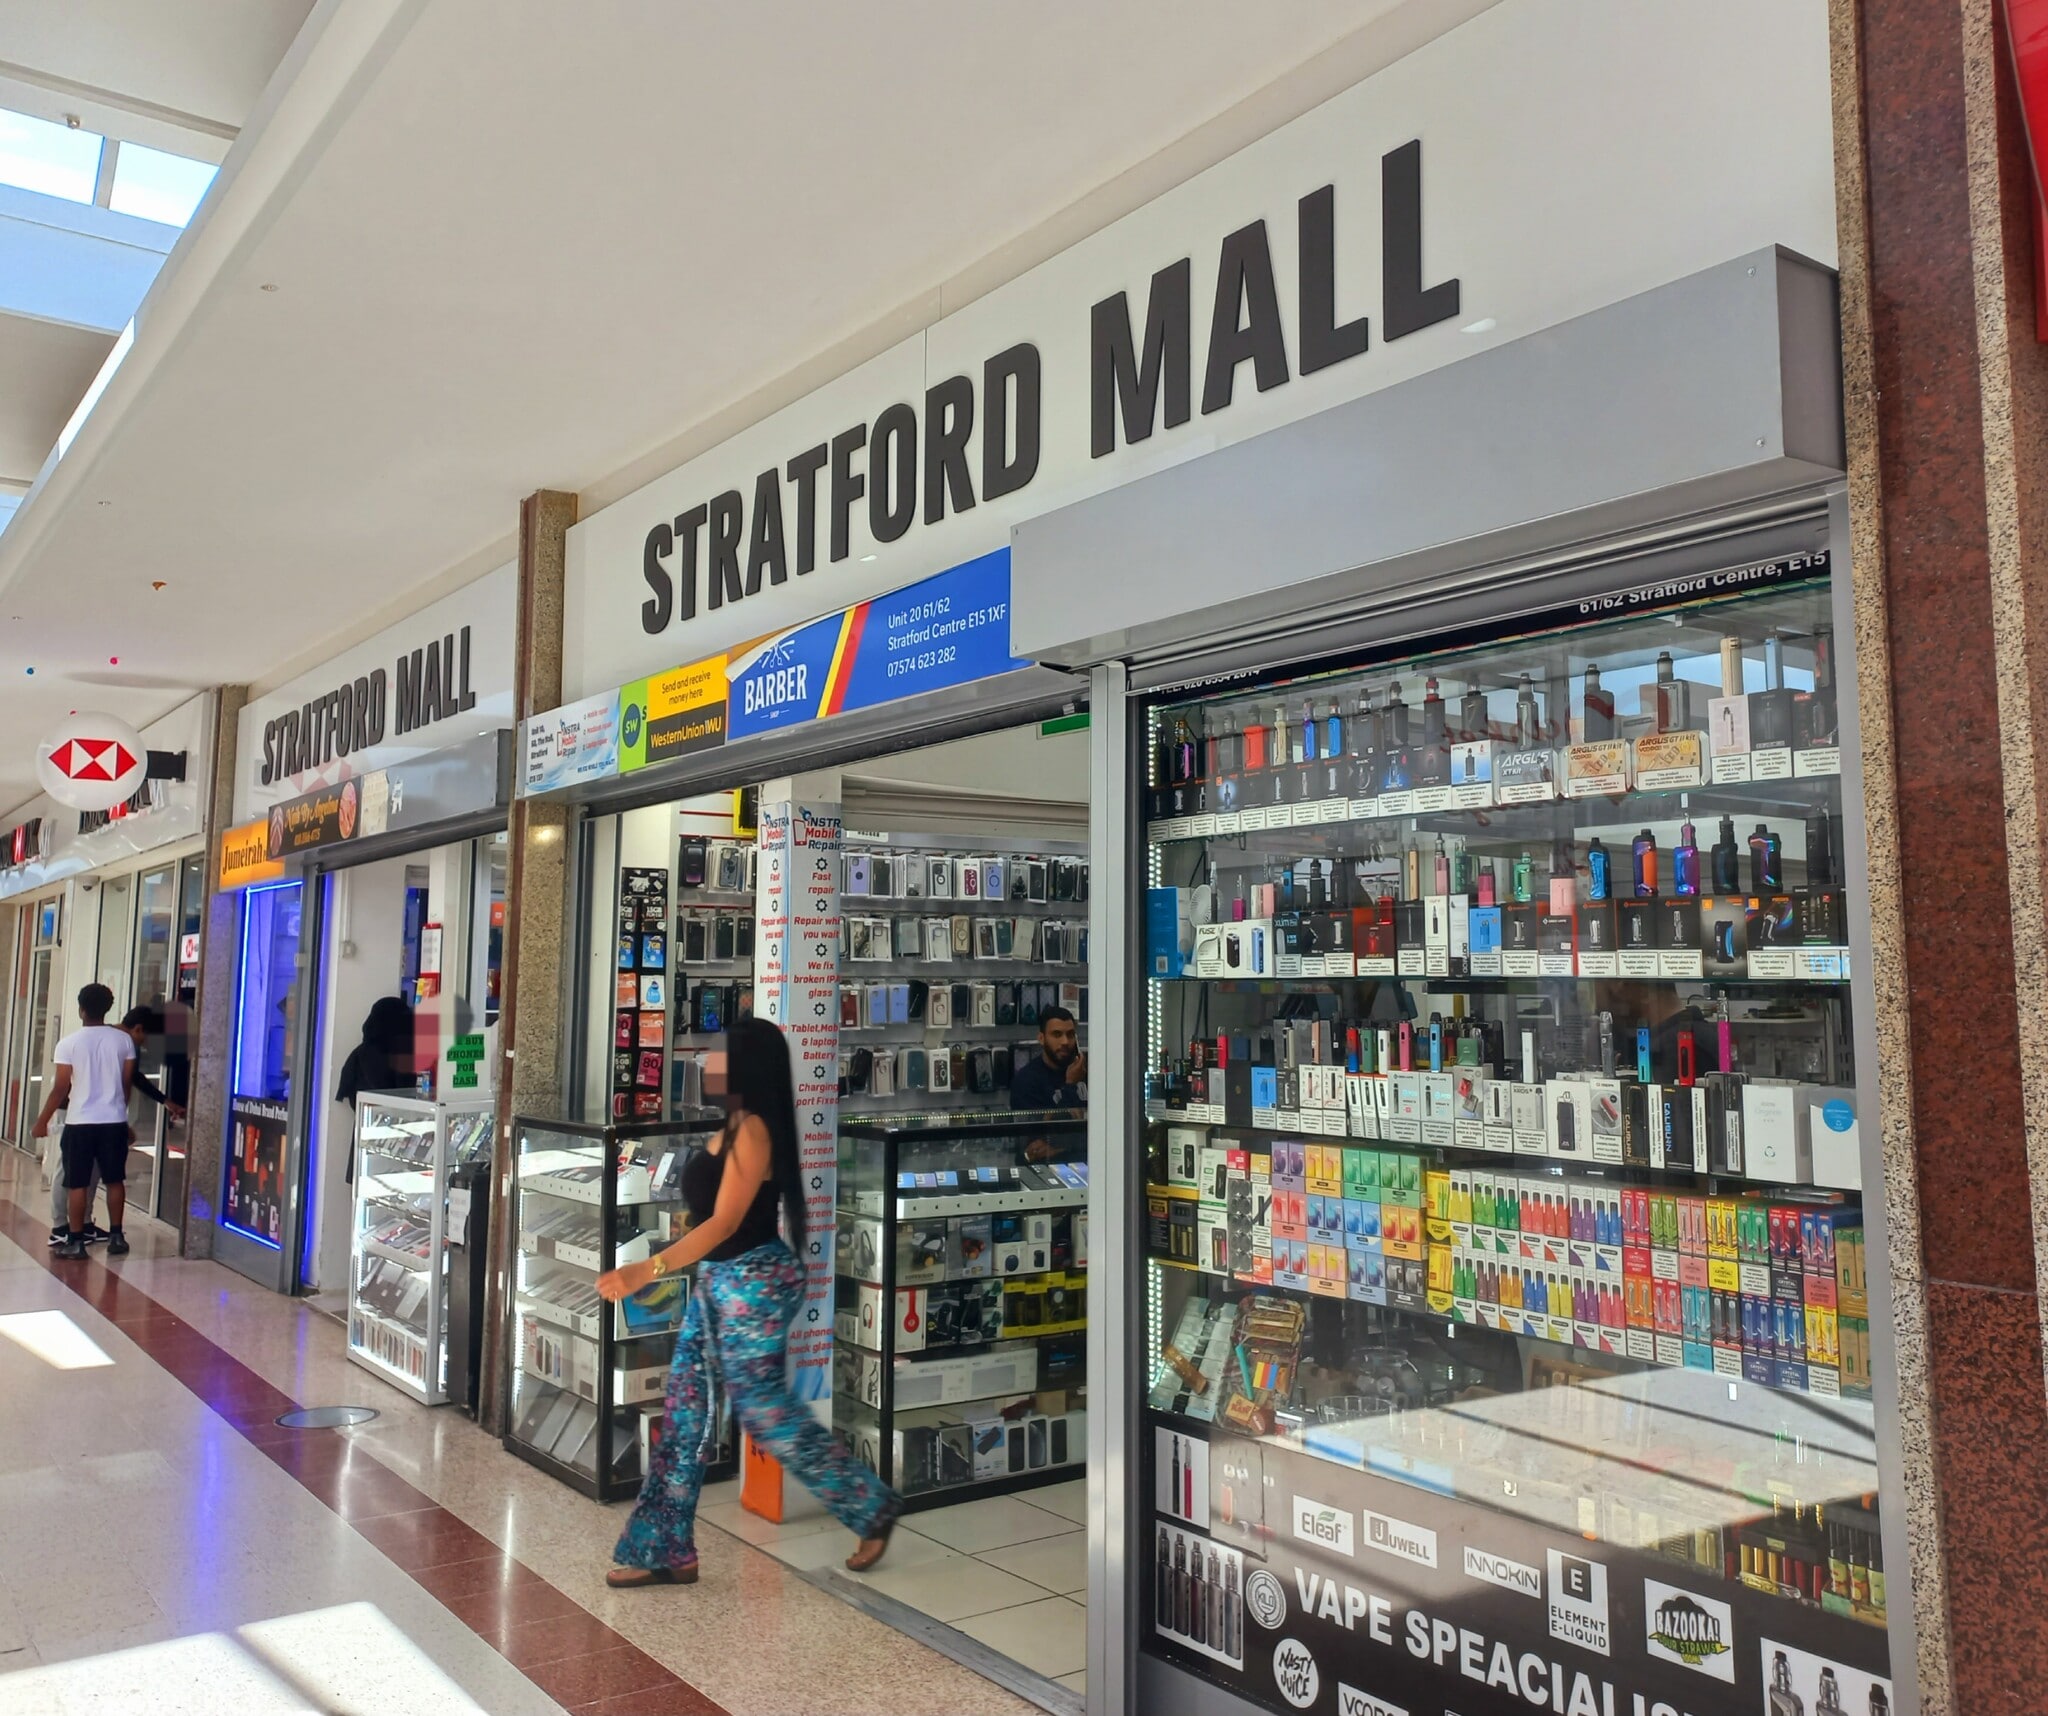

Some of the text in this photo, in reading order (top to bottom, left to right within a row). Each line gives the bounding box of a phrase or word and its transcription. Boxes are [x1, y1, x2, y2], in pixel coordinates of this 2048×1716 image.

[642, 138, 1460, 635] STRATFORD MALL
[1580, 551, 1827, 614] 61/62 Stratford Centre, E15
[888, 597, 950, 629] Unit 20 61/62
[887, 603, 1006, 651] Stratford Centre E15 1XF
[887, 646, 956, 678] 07574 623 282
[661, 670, 711, 694] Send and receive
[745, 663, 807, 716] BARBER
[668, 687, 703, 706] money here
[261, 625, 476, 786] STRATFORD MALL
[650, 721, 705, 749] WesternUnion
[1638, 736, 1669, 747] ARGUS
[1669, 735, 1679, 744] GT
[1570, 744, 1598, 755] ARGUS
[1598, 744, 1608, 752] GT
[1502, 750, 1550, 769] ARGUS
[222, 836, 263, 876] Jumeirah
[812, 872, 832, 881] Fast
[807, 886, 835, 896] repair
[793, 916, 824, 927] Repair
[803, 930, 840, 941] you wait
[807, 961, 834, 970] We fix
[793, 974, 825, 984] broken
[808, 988, 833, 999] glass
[465, 1036, 485, 1046] BUY
[801, 1036, 838, 1048] & laptop
[447, 1049, 485, 1060] PHONES
[803, 1051, 836, 1061] Battery
[456, 1063, 475, 1073] FOR
[642, 1057, 659, 1069] 80
[453, 1075, 478, 1086] CASH
[798, 1082, 840, 1093] Charging
[795, 1096, 840, 1108] port Fixed
[1664, 1102, 1672, 1152] CALIBURN
[804, 1131, 833, 1141] Mobile
[1624, 1114, 1632, 1158] CALIBURN
[802, 1145, 834, 1155] screen
[807, 1195, 833, 1206] aptop
[806, 1209, 832, 1219] creen
[788, 1344, 811, 1355] back
[796, 1356, 830, 1368] change
[1301, 1511, 1342, 1544] Eleaf
[1388, 1535, 1430, 1560] UWELL
[1466, 1551, 1539, 1592] INNOKIN
[1294, 1567, 1393, 1646] VAPE
[1550, 1605, 1607, 1633] ELEMENT
[1655, 1610, 1720, 1643] BAZOOKA!
[1550, 1619, 1607, 1649] E-LIQUID
[1680, 1641, 1717, 1655] STRAWS
[1279, 1647, 1313, 1675] NASTY
